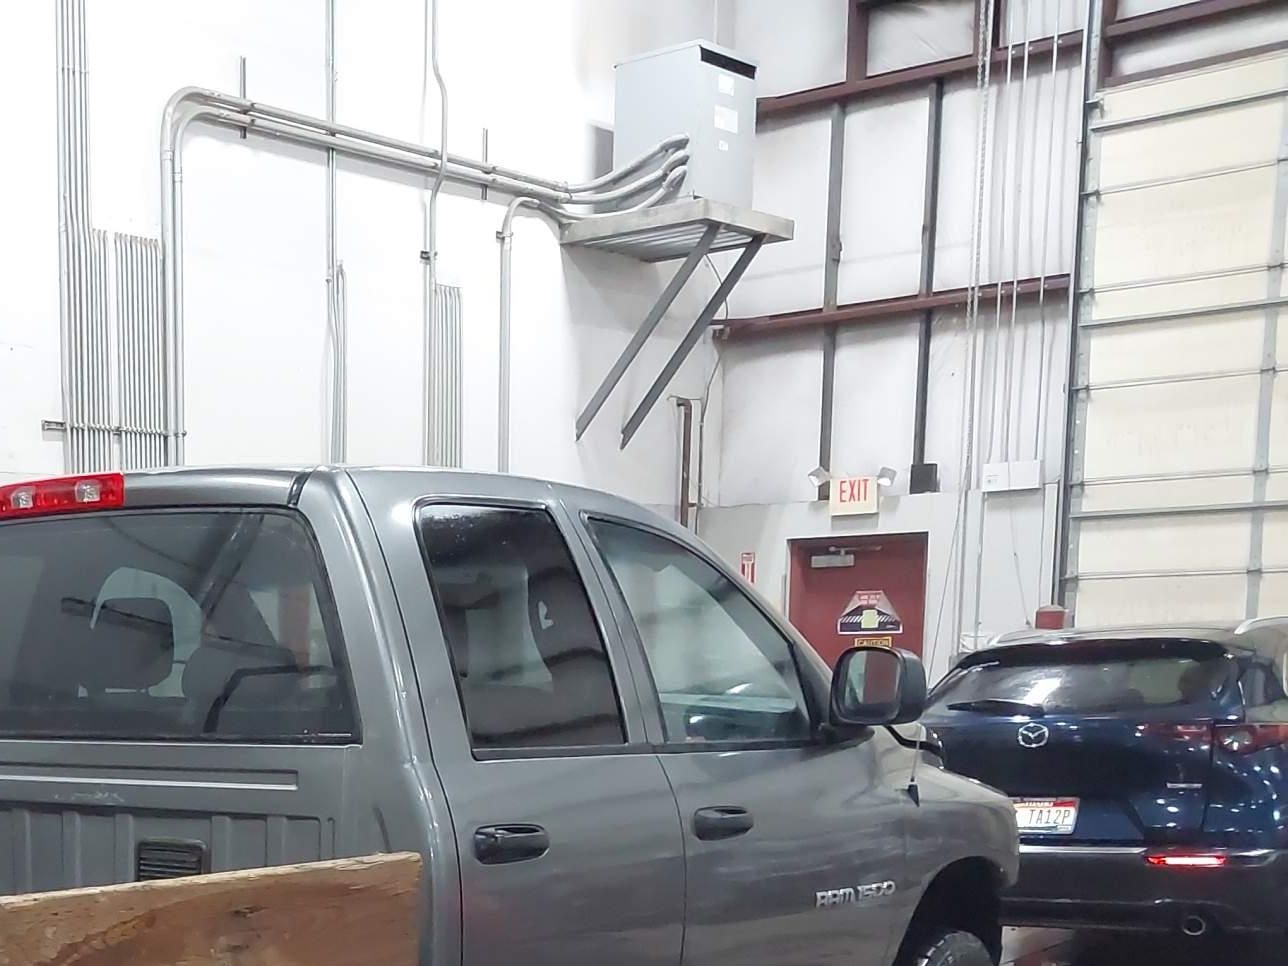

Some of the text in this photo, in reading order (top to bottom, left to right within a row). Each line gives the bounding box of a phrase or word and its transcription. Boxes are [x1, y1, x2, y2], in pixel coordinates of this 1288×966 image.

[839, 478, 869, 503] EXIT
[1028, 809, 1072, 825] TA12P
[815, 881, 896, 908] RAM 1500
